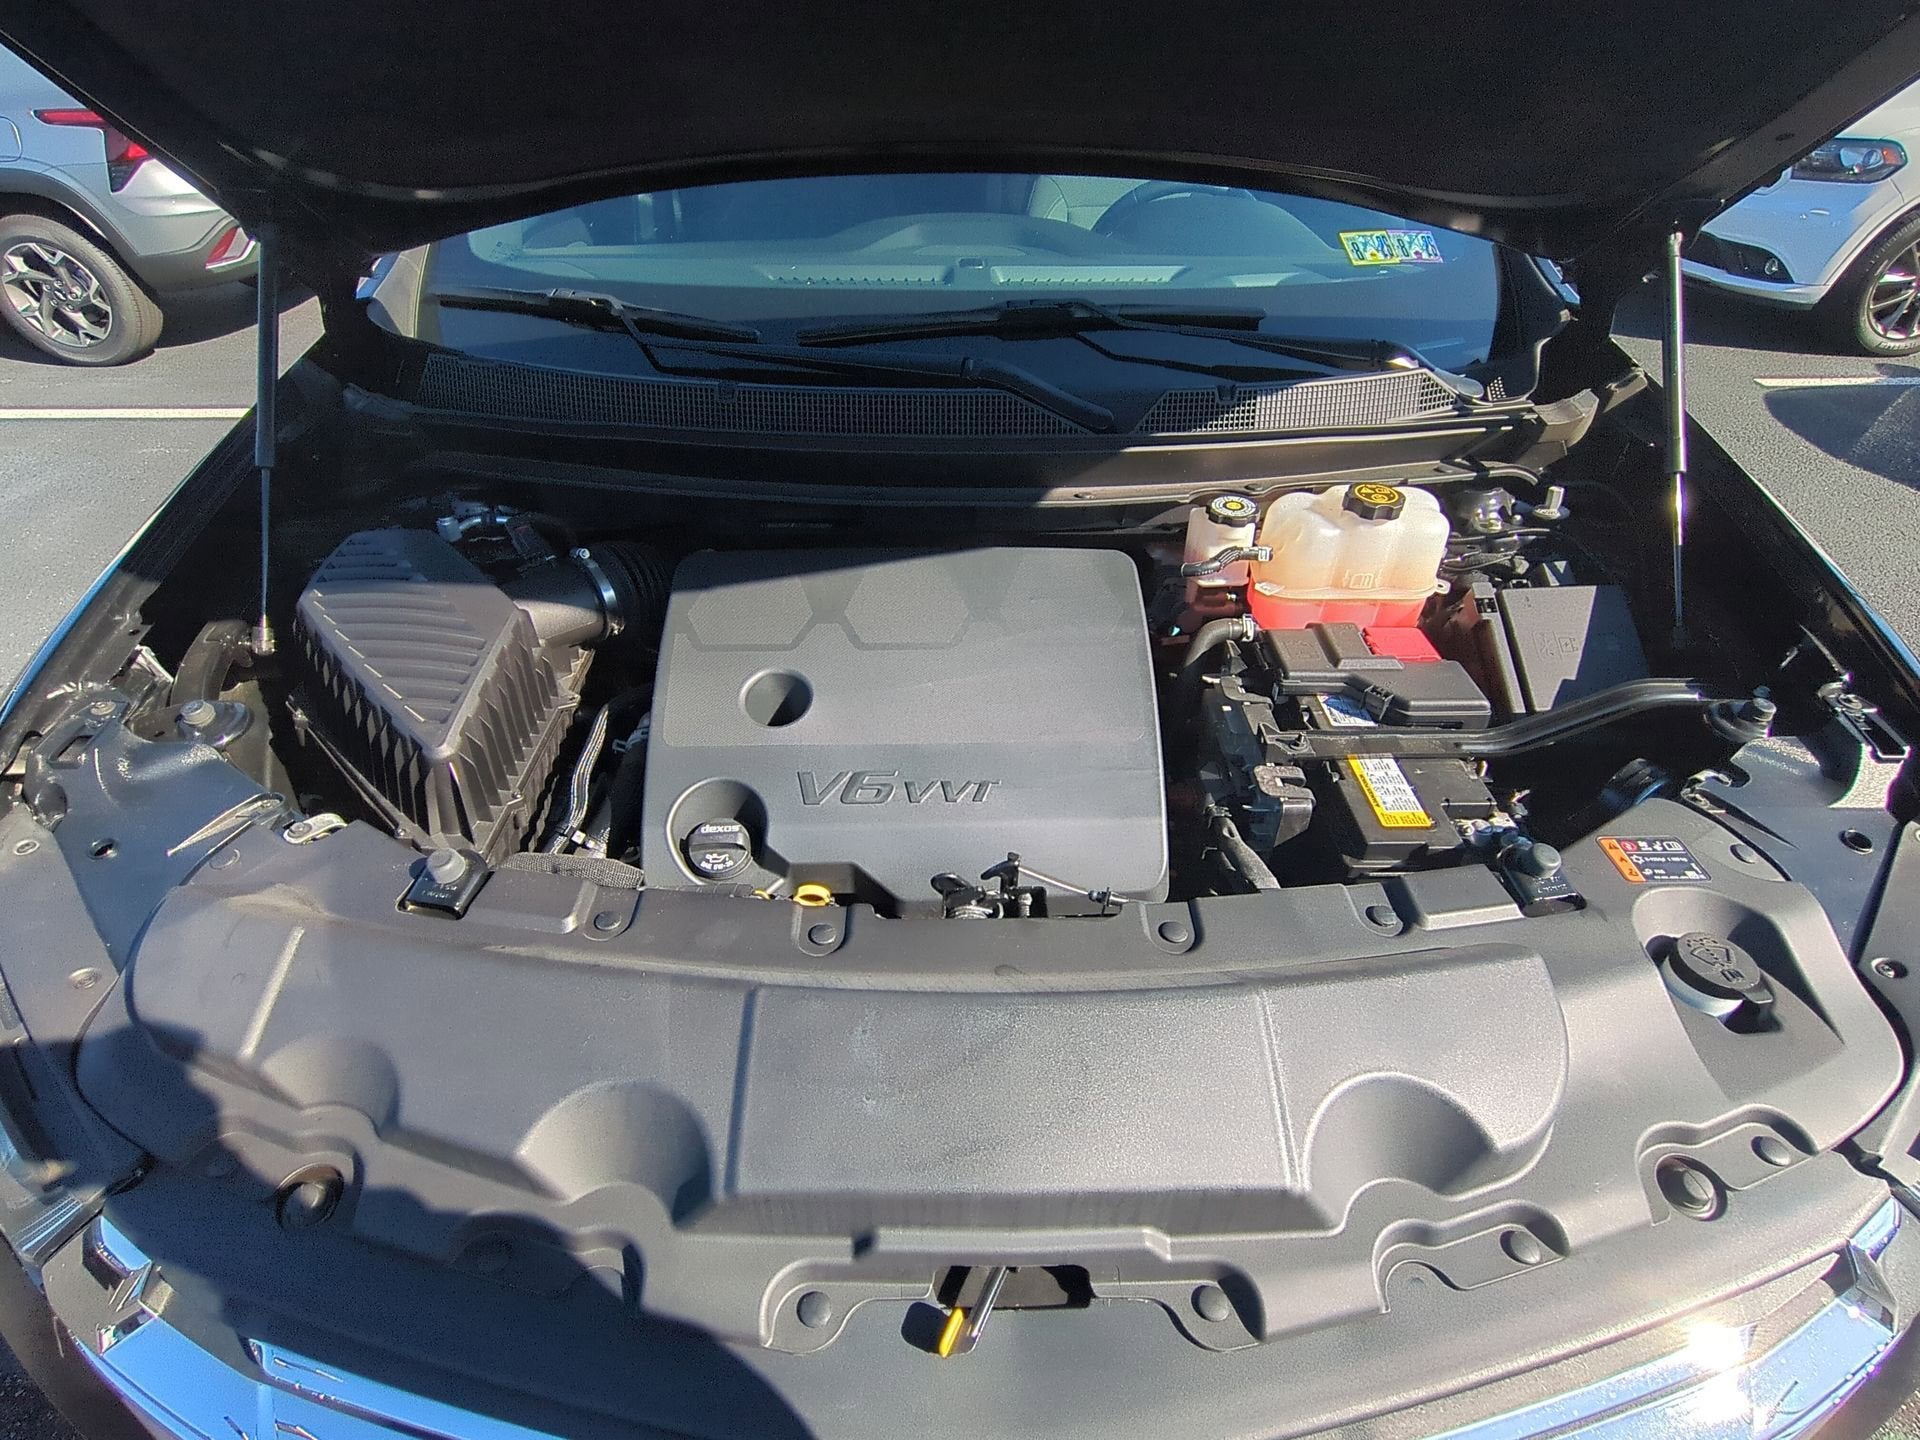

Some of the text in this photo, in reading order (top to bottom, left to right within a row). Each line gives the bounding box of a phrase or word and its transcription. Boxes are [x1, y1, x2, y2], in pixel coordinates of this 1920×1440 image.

[1351, 241, 1365, 261] 8
[1397, 238, 1410, 258] 8
[797, 770, 1002, 806] V6 VVT
[701, 824, 741, 834] dexos
